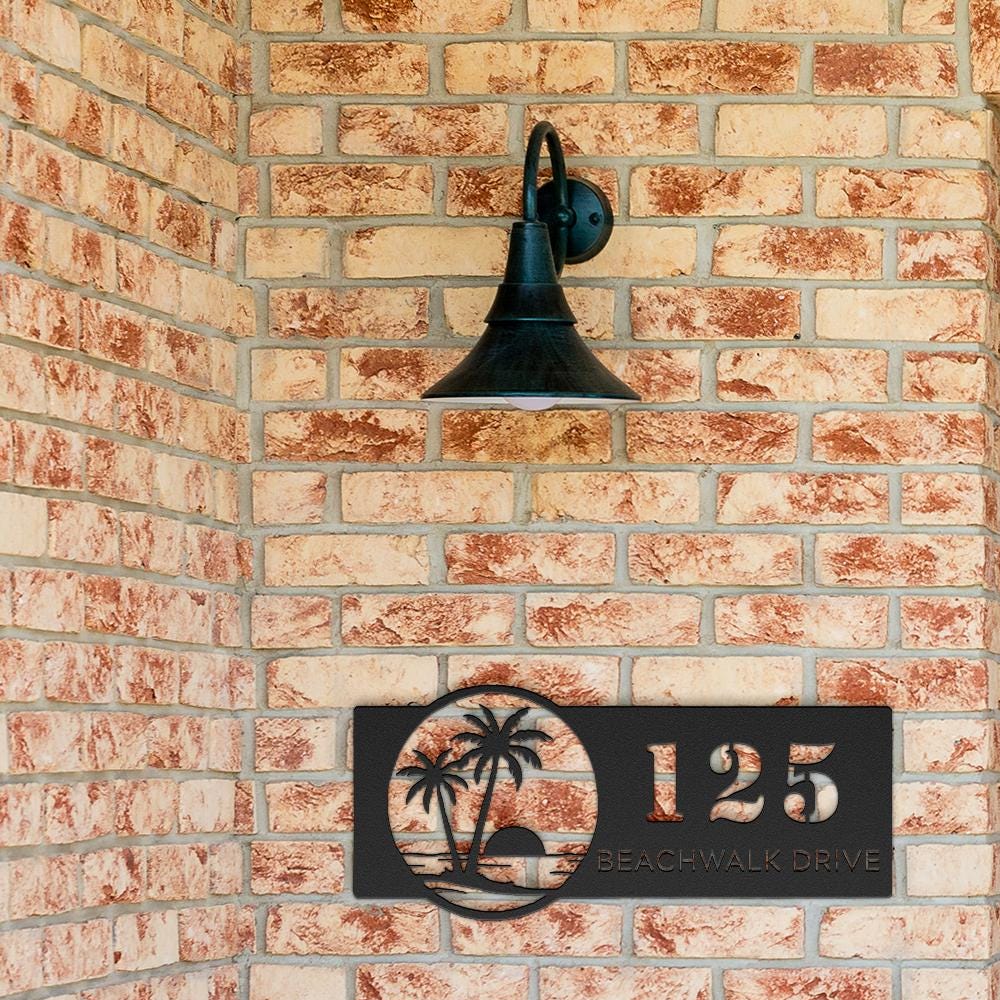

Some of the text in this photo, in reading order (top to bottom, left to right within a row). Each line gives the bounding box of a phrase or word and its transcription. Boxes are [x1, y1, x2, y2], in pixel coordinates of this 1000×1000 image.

[646, 741, 838, 824] 125
[597, 848, 881, 873] BEACHWALK DRIVE
